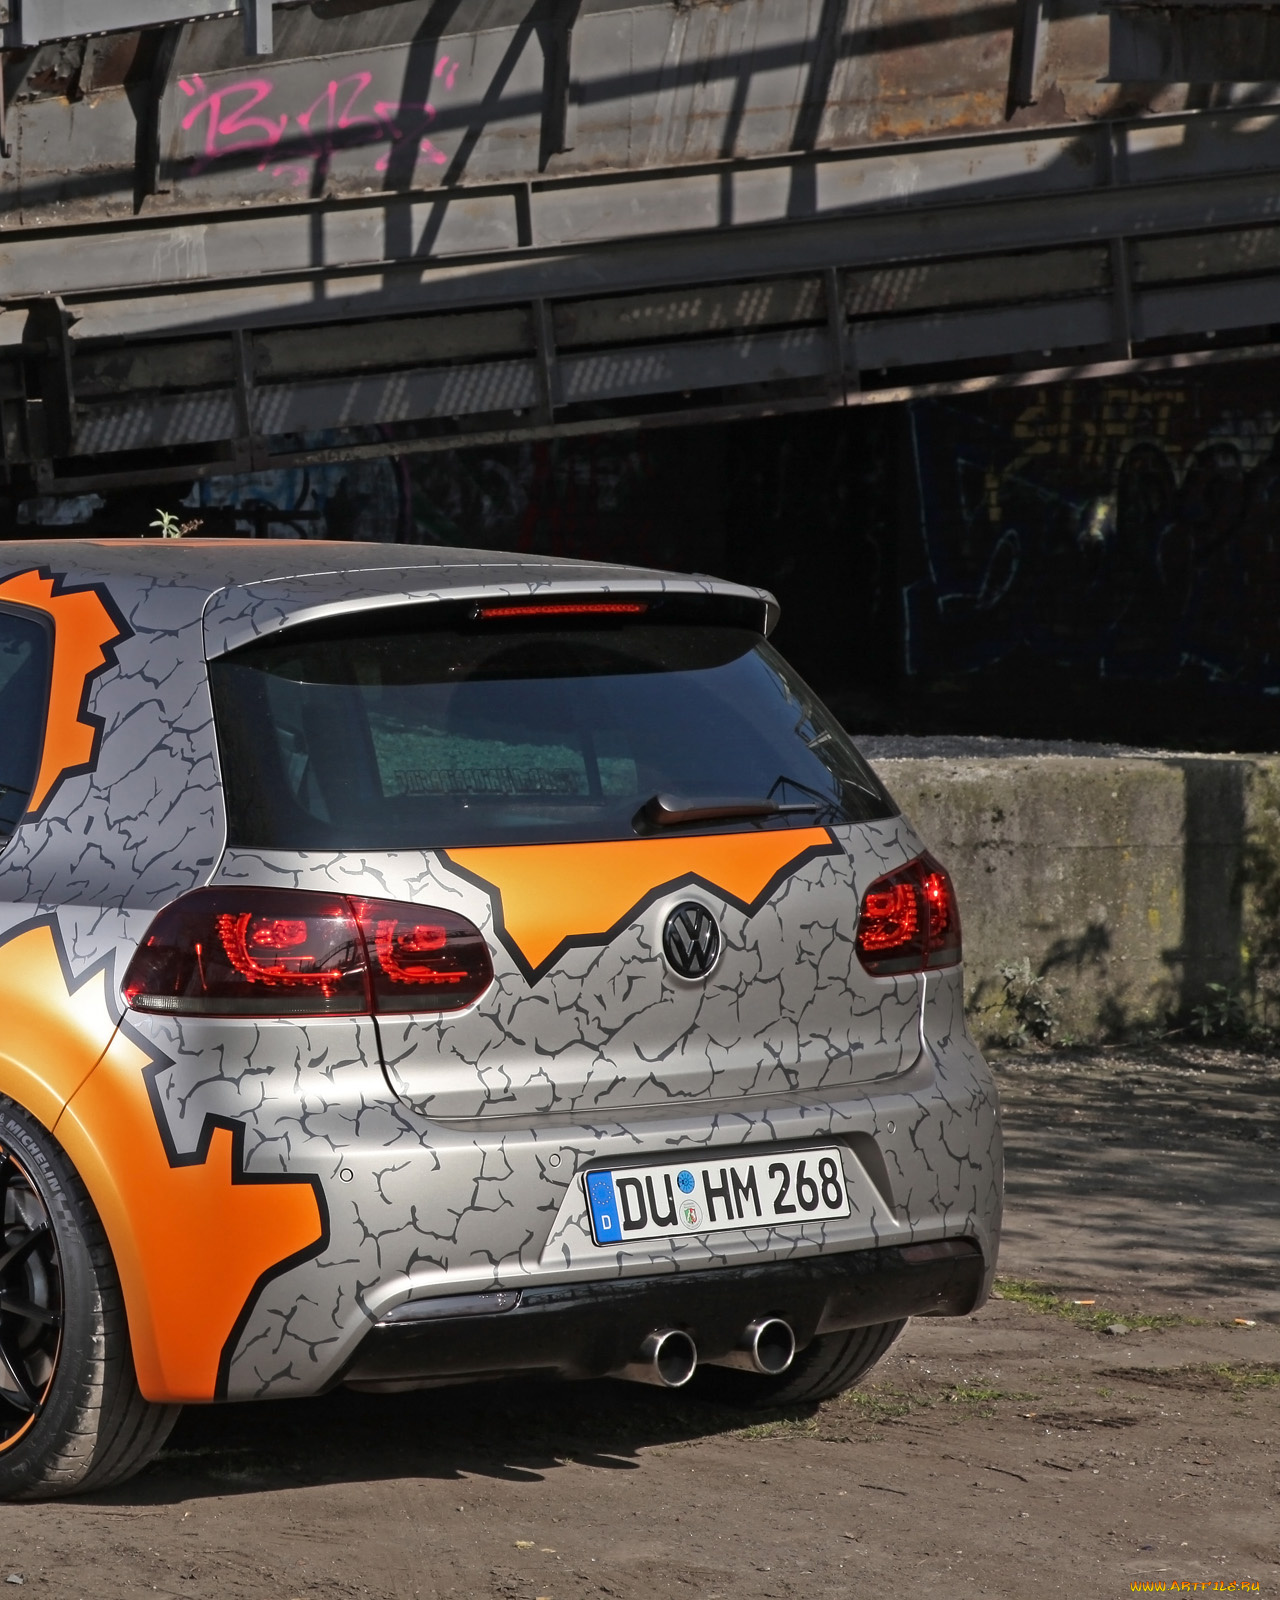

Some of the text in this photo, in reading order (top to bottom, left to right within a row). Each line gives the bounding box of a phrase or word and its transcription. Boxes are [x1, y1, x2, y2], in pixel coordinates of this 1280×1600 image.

[5, 1119, 62, 1192] MICHELIN
[601, 1157, 843, 1231] D DU HM 268
